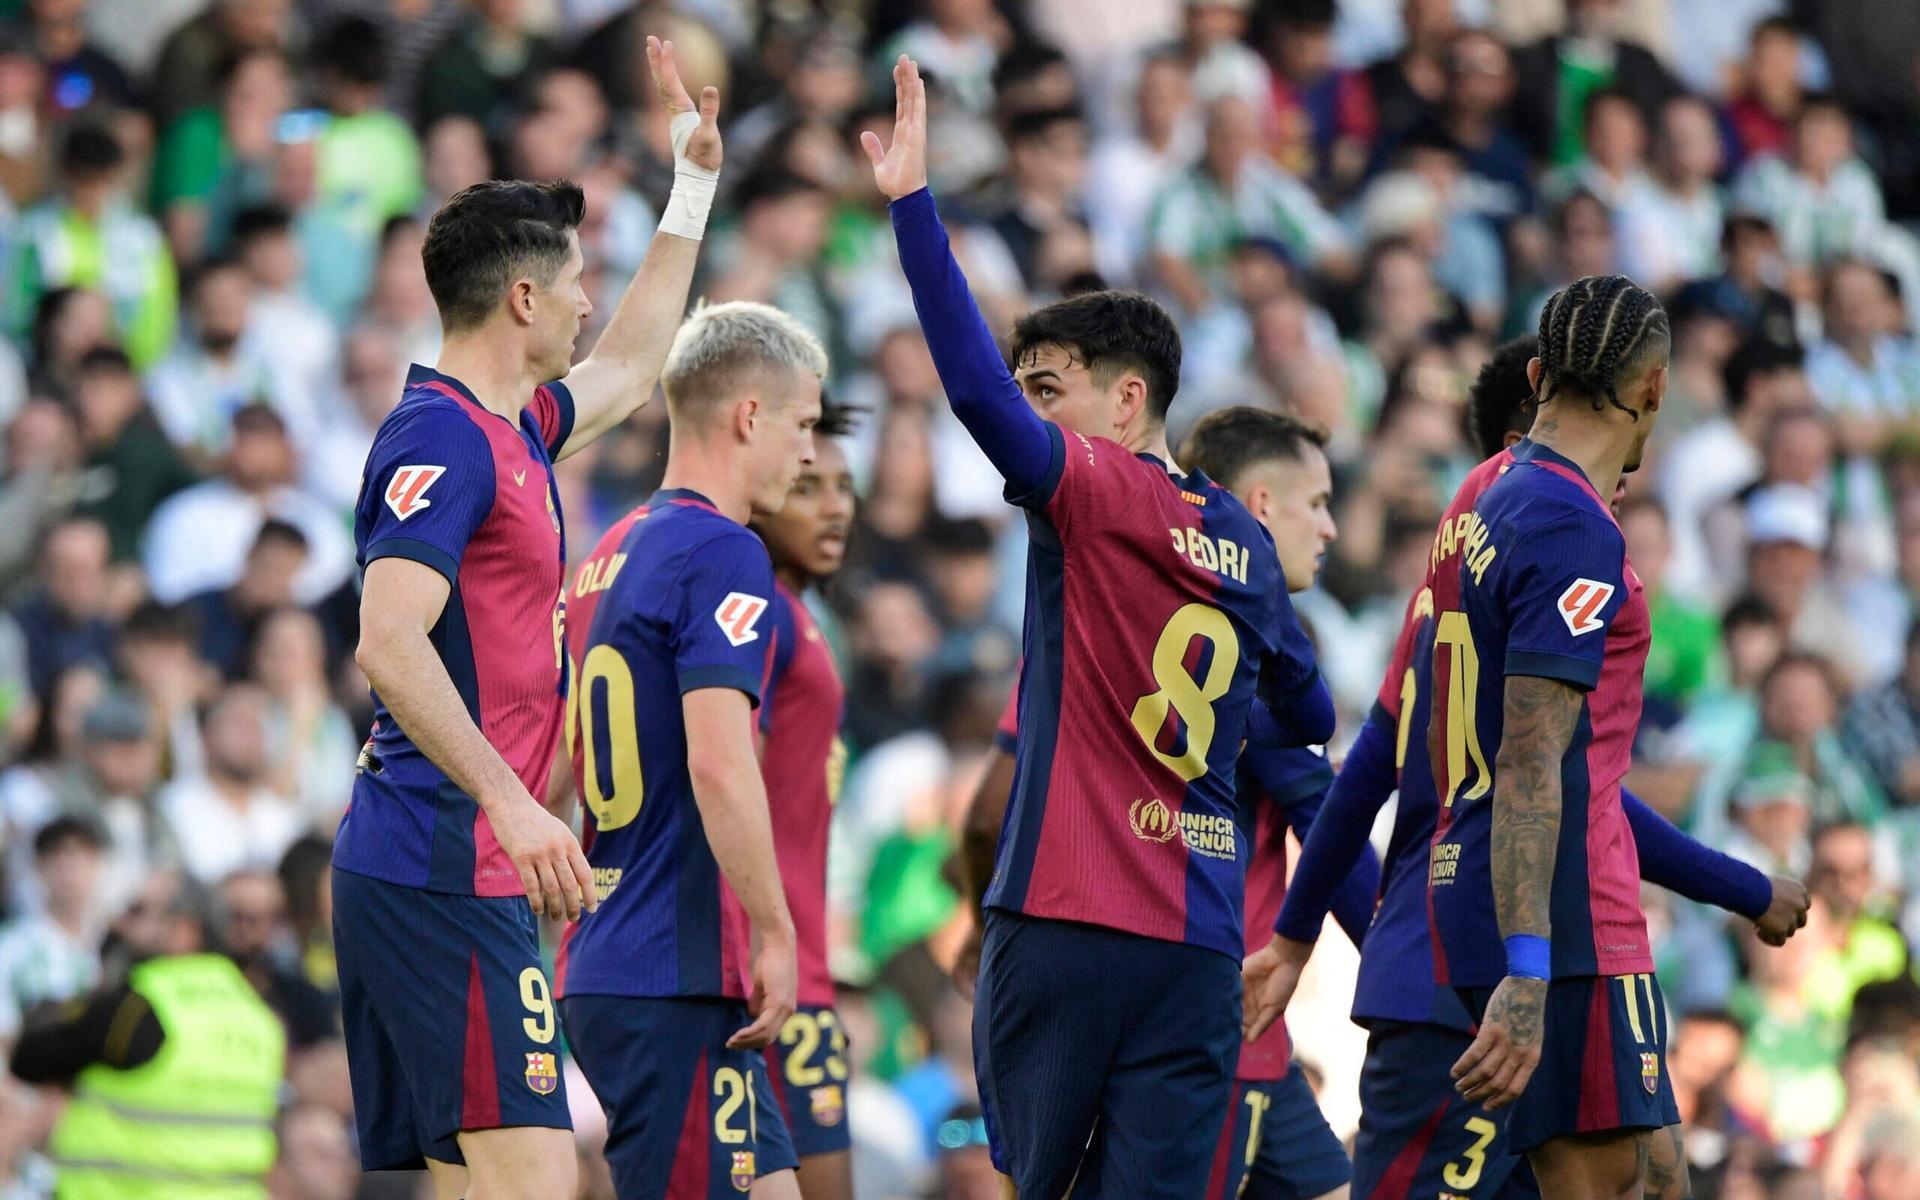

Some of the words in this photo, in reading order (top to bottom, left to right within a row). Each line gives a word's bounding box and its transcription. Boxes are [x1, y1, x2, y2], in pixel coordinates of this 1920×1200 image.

[1130, 602, 1240, 783] 8
[1174, 811, 1234, 836] UNHCR
[1181, 828, 1236, 853] ACNUR
[518, 967, 555, 1044] 9
[1615, 973, 1658, 1045] 11
[780, 1010, 848, 1087] 23
[713, 1067, 757, 1144] 2
[1244, 1089, 1271, 1166] 1
[1443, 1116, 1496, 1190] 3
